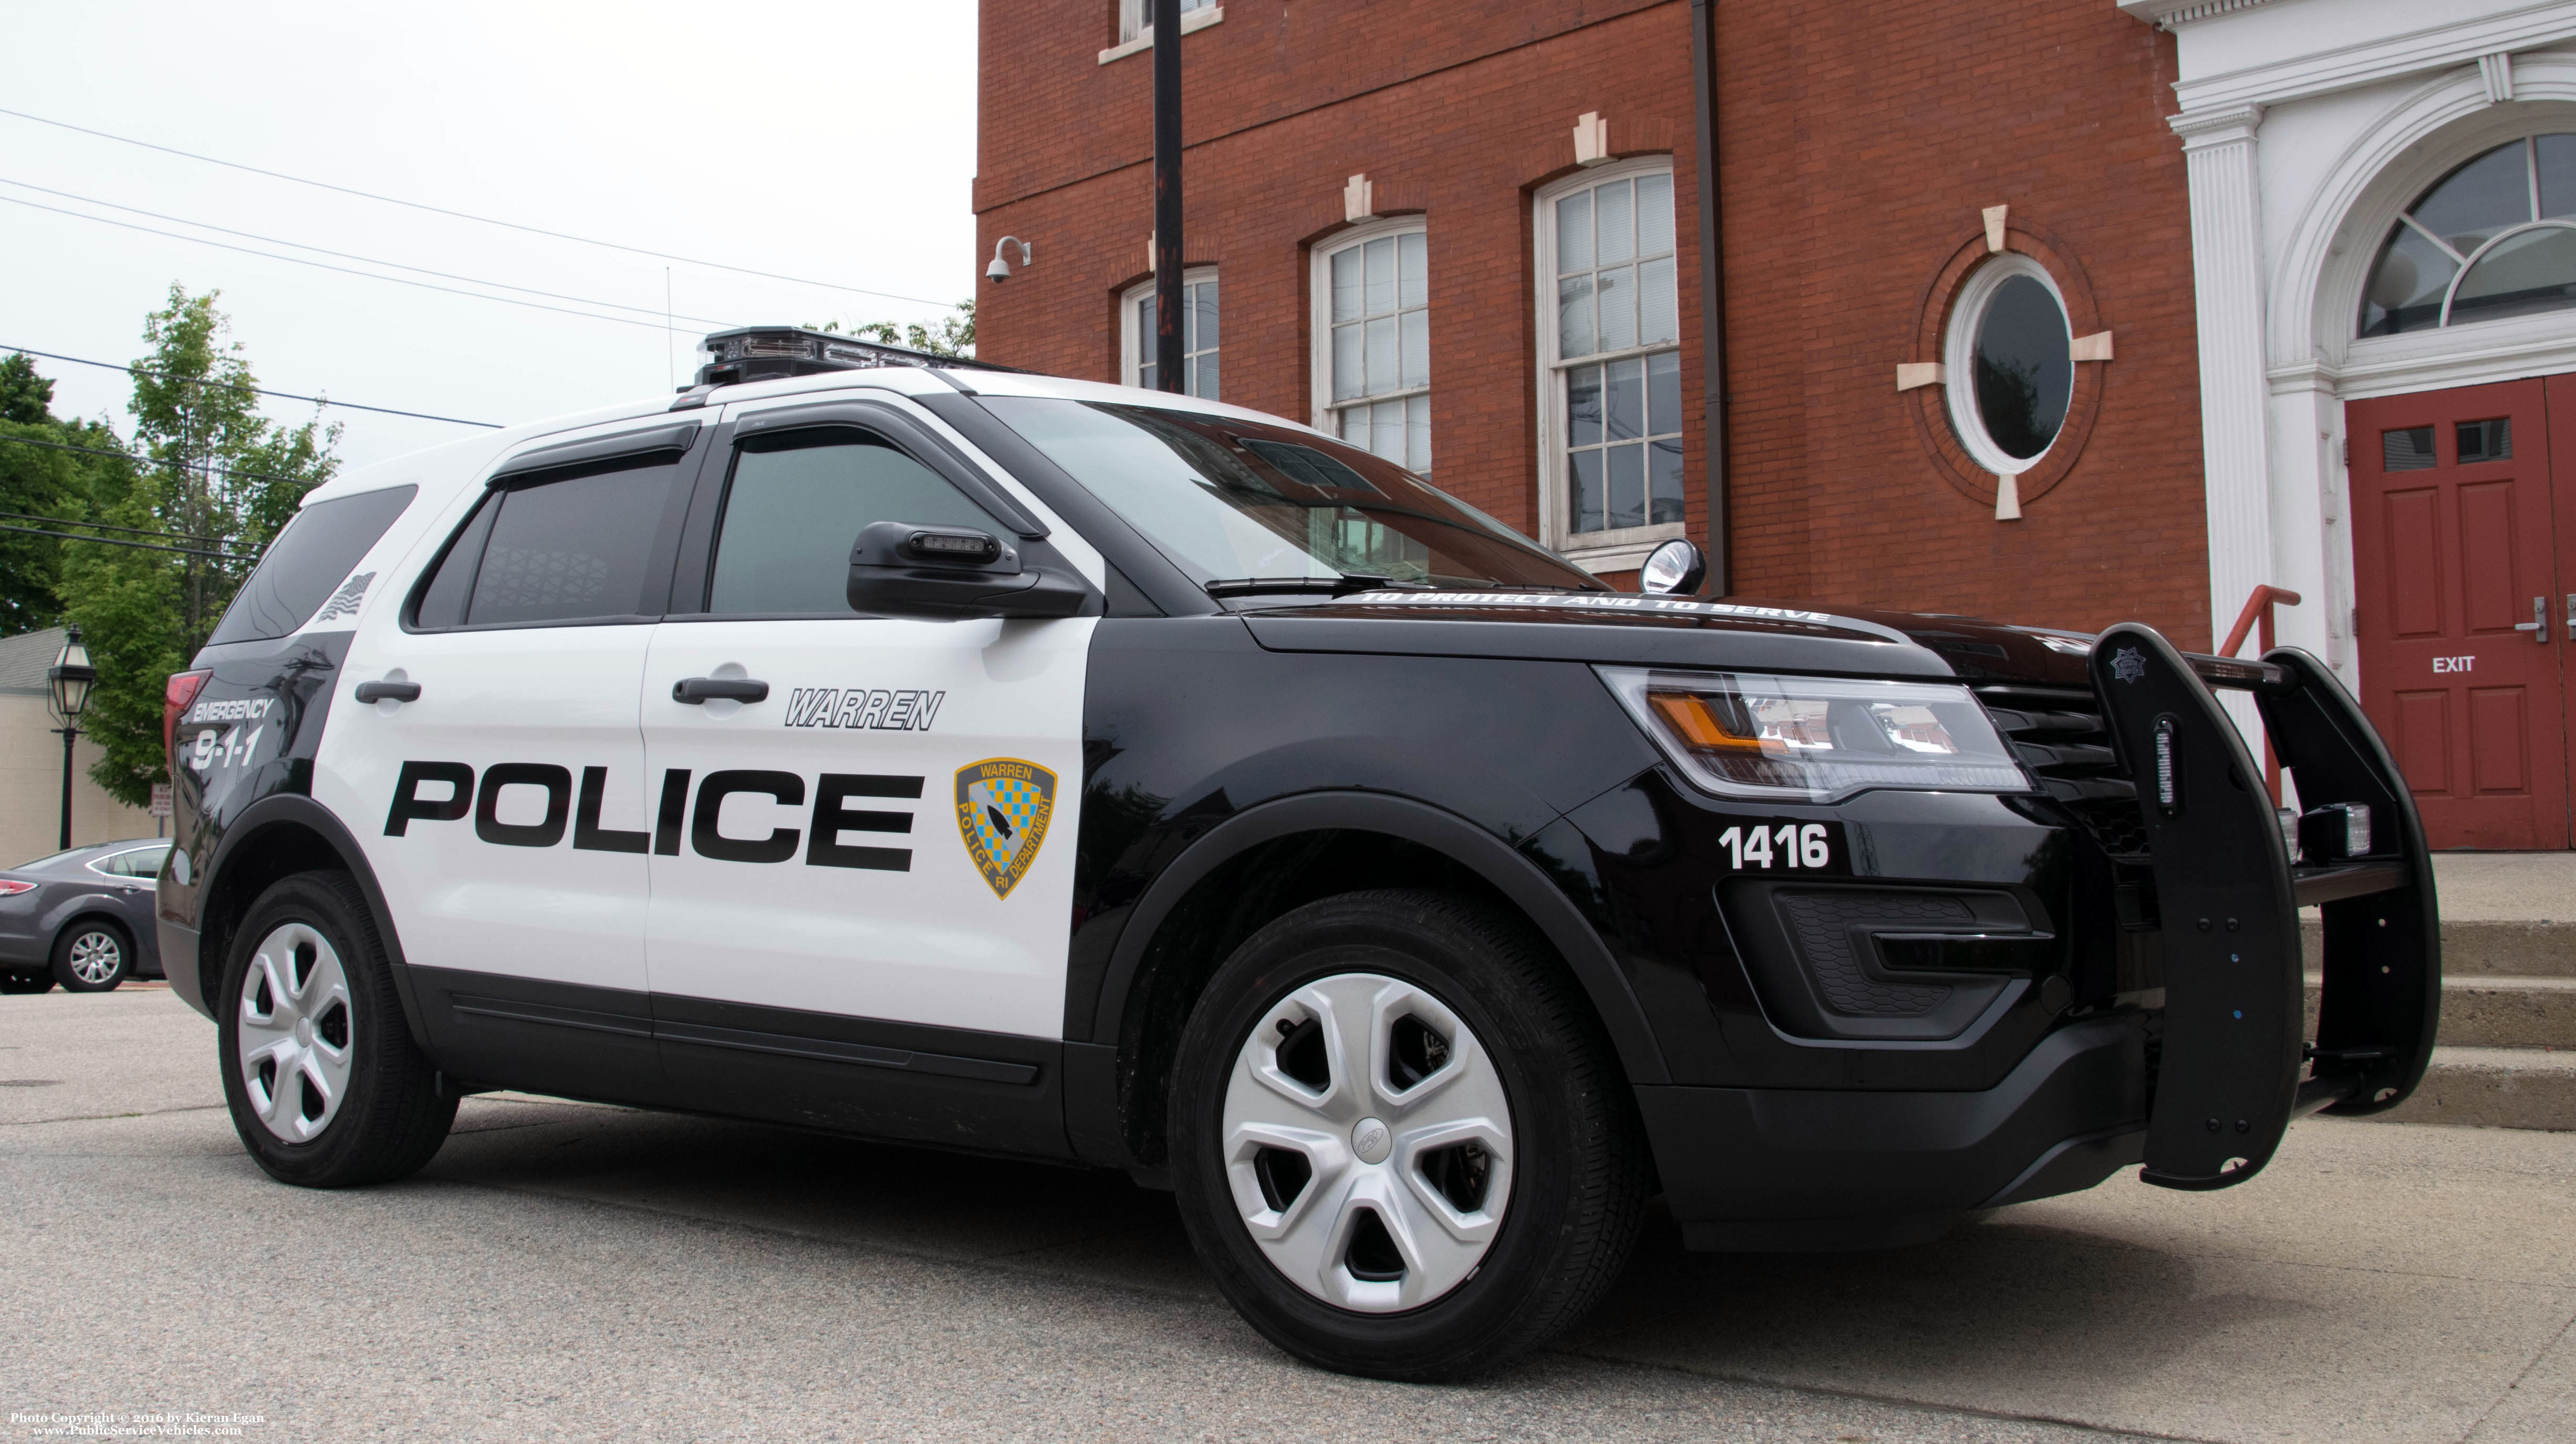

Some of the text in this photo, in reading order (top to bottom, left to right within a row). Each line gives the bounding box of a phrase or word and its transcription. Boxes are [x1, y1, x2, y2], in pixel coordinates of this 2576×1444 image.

[1361, 593, 1831, 621] TO PROTECT AND TO SERVE
[2433, 656, 2475, 673] EXIT
[193, 698, 275, 722] EMERGENCY
[785, 688, 946, 731] WARREN
[192, 724, 264, 770] 9-1-1
[980, 764, 1033, 780] WARREN
[384, 760, 925, 872] POLICE
[1009, 795, 1050, 879] DEPARTMENT
[959, 802, 993, 875] POLICE
[1718, 824, 1829, 869] 1416
[996, 876, 1008, 888] RI
